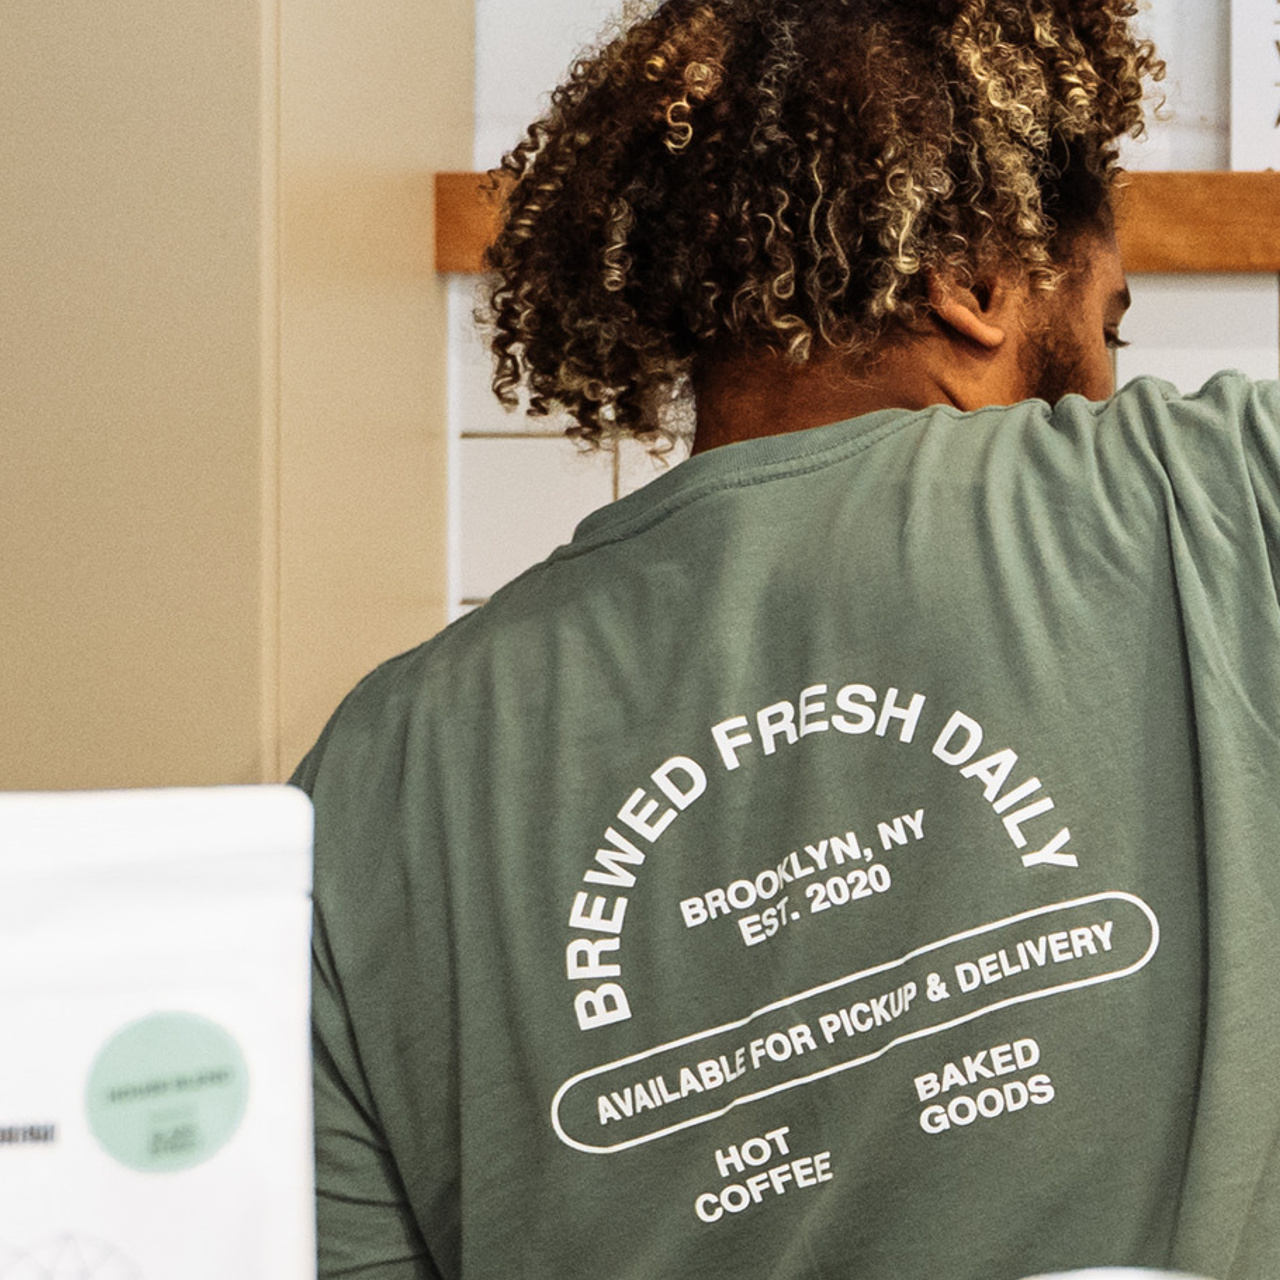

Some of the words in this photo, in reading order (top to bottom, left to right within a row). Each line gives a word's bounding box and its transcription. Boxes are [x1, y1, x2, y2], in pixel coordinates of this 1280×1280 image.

[566, 756, 709, 1031] BREWED
[711, 684, 926, 771] FRESH
[932, 710, 1079, 868] DAILY
[679, 831, 874, 928] BROOKLYN,
[877, 809, 928, 856] NY
[736, 893, 801, 947] EST.
[804, 863, 892, 914] 2020
[596, 1048, 748, 1125] AVAILABLE
[750, 1024, 818, 1069] FOR
[818, 981, 917, 1044] PICKUP
[926, 972, 951, 1002] &
[953, 920, 1115, 995] DELIVERY
[914, 1038, 1042, 1103] BAKED
[918, 1073, 1055, 1134] GOODS
[695, 1151, 833, 1223] COFFEE
[715, 1126, 793, 1179] HOT
